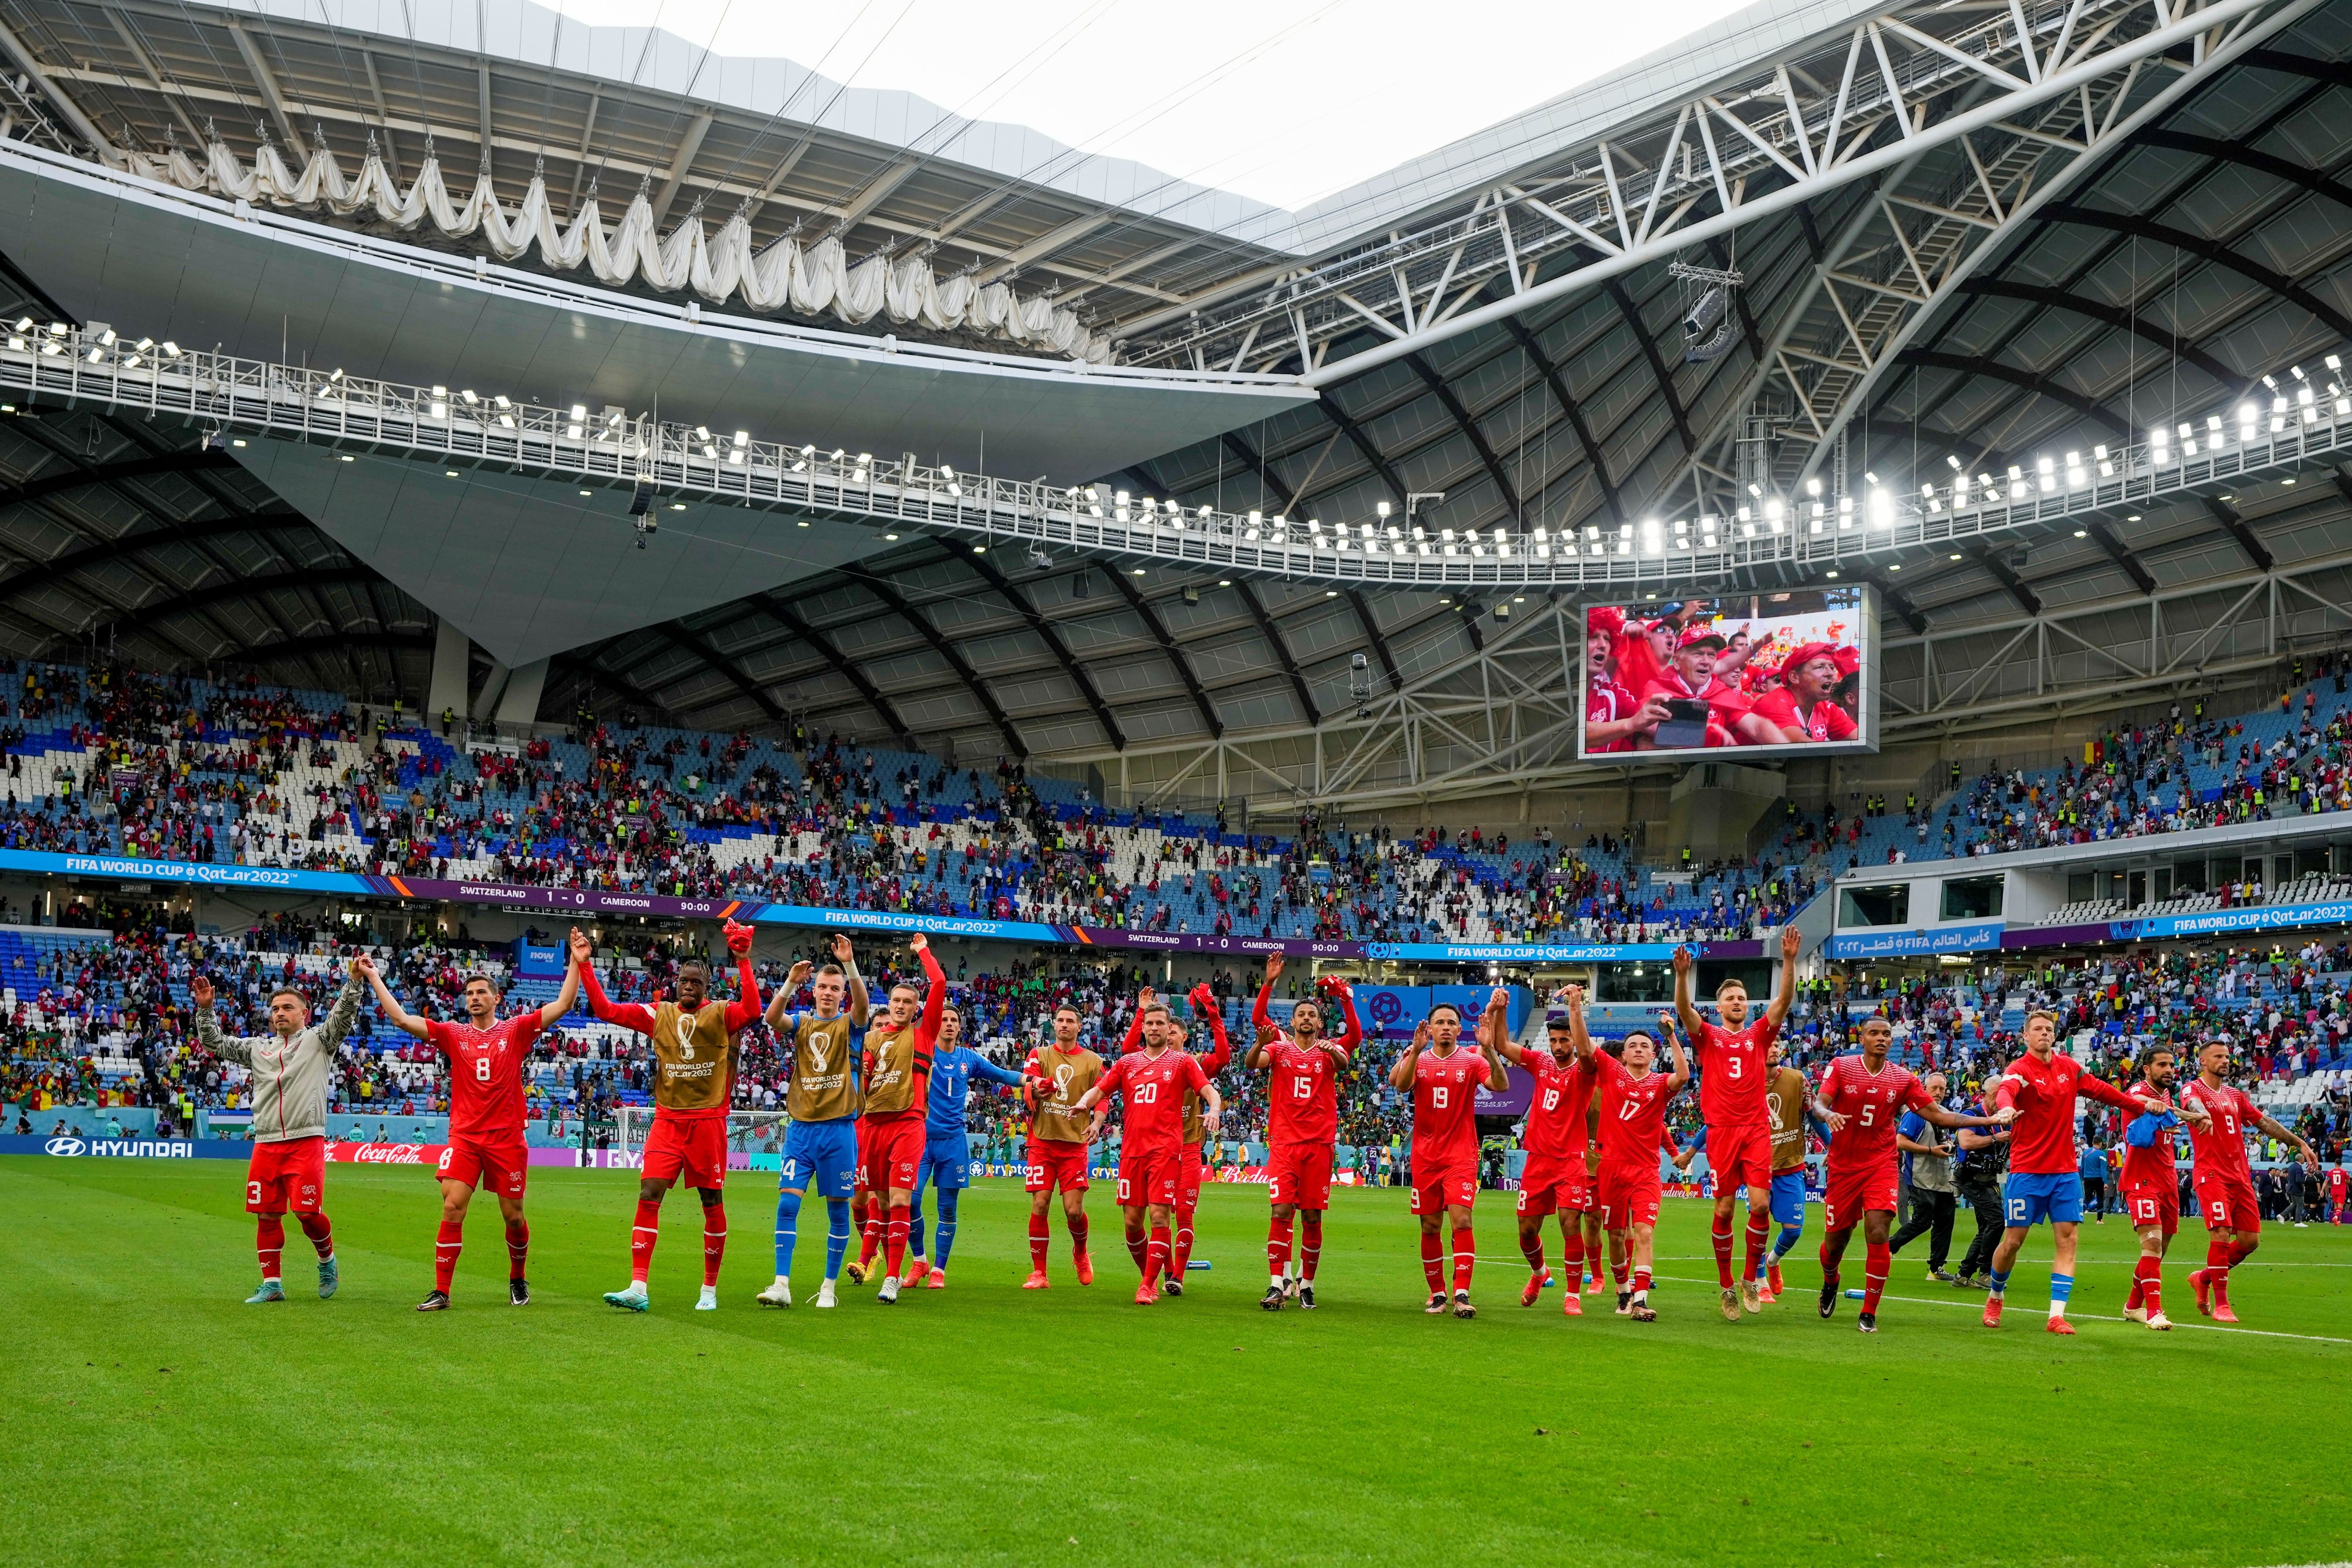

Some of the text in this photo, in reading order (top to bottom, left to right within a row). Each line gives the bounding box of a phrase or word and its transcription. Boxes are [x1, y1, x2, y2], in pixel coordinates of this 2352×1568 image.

[66, 858, 98, 871] FIFA
[100, 860, 153, 874] WORLD
[156, 865, 183, 876] CUP
[460, 886, 526, 898] SWITZERLAND
[547, 891, 552, 902] 1
[575, 893, 585, 904] 0
[601, 897, 650, 907] CAMEROON
[681, 902, 710, 912] 90:00
[825, 912, 848, 923] FIFA
[850, 914, 891, 926] WORLD
[893, 917, 915, 927] CUP
[2174, 919, 2196, 931] FIFA
[2198, 916, 2237, 929] WORLD
[2239, 913, 2260, 925] CUP
[1128, 933, 1180, 944] SWITZERLAND
[1196, 937, 1201, 947] 1
[1220, 938, 1228, 948] 0
[1242, 941, 1285, 950] CAMEROON
[1905, 937, 1930, 948] FIFA
[1933, 933, 1961, 949] العالم
[1964, 928, 1990, 947] كأس
[530, 951, 555, 960] now
[1448, 947, 1471, 956] FIFA
[1473, 948, 1512, 958] WORLD
[1514, 948, 1535, 958] CUP
[476, 1057, 490, 1081] 8
[667, 1068, 712, 1079] Qatar2022
[1729, 1057, 1742, 1078] 3
[802, 1080, 843, 1091] Qatar2022
[948, 1077, 952, 1097] 1
[1134, 1083, 1157, 1104] 20
[1293, 1077, 1311, 1099] 15
[1051, 1102, 1070, 1110] WORLD
[1433, 1087, 1448, 1109] 19
[1542, 1088, 1560, 1110] 18
[1619, 1100, 1640, 1121] 17
[1860, 1104, 1876, 1126] 5
[2225, 1114, 2235, 1134] 9
[91, 1140, 192, 1158] HYUNDAI
[354, 1143, 424, 1163] Coca-Cola
[439, 1147, 454, 1170] 8
[1369, 1150, 1377, 1158] 23
[780, 1159, 795, 1181] 4
[1025, 1166, 1044, 1185] 22
[1709, 1169, 1719, 1191] 3
[2332, 1174, 2341, 1185] 10
[248, 1181, 261, 1204] 3
[1269, 1177, 1279, 1198] 5
[1411, 1187, 1421, 1209] 9
[1517, 1190, 1527, 1210] 8
[1601, 1205, 1611, 1225] 7
[1827, 1204, 1835, 1226] 5
[2008, 1198, 2026, 1220] 12
[2137, 1199, 2155, 1219] 13
[2212, 1201, 2226, 1220] 9
